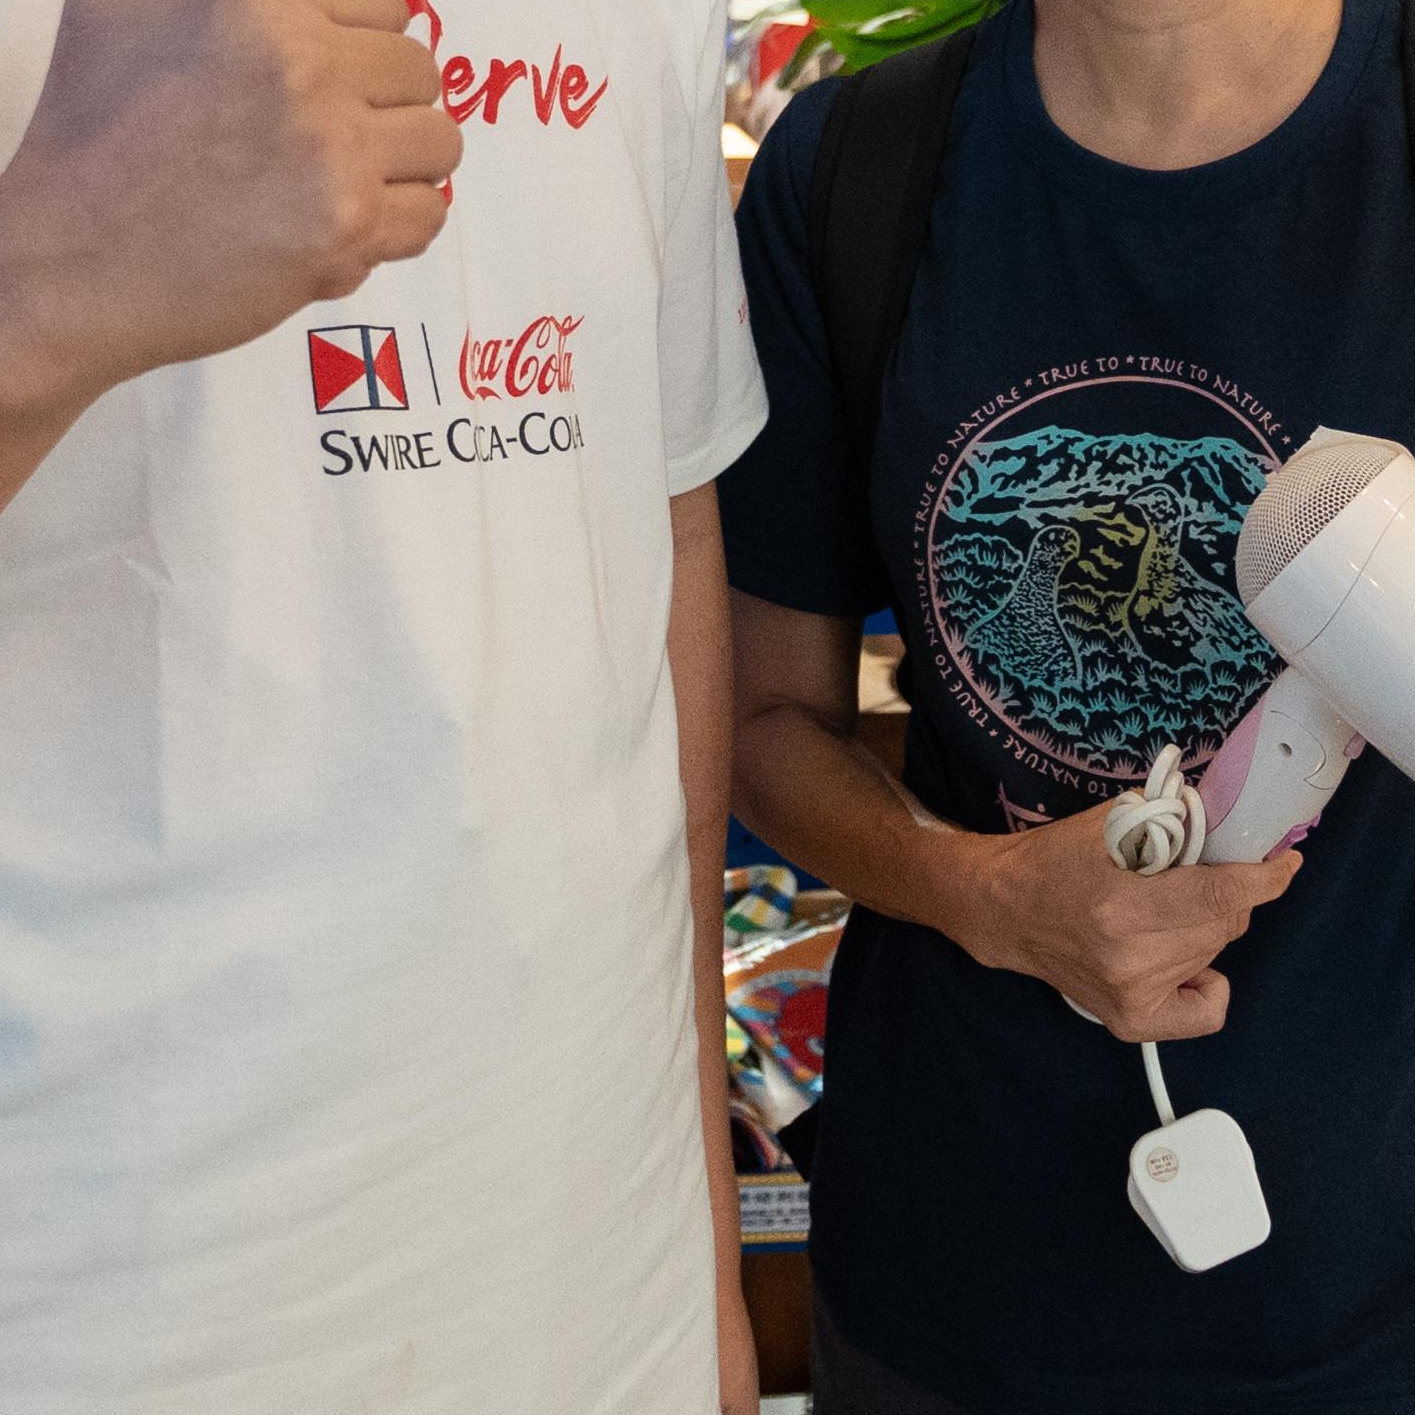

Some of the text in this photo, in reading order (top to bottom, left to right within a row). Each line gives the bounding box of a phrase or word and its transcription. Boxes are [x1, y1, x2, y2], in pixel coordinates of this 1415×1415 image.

[1037, 358, 1090, 386] TRUE
[1096, 355, 1120, 372] TO
[1139, 355, 1184, 377] TRUE
[1189, 363, 1209, 383] TO
[947, 387, 1022, 451] NATURE
[1213, 378, 1282, 435] NATURE
[320, 429, 442, 477] SWIRE
[931, 452, 951, 476] TO
[914, 480, 937, 535] TRUE
[934, 654, 954, 680] TO
[949, 682, 989, 729] TRUE
